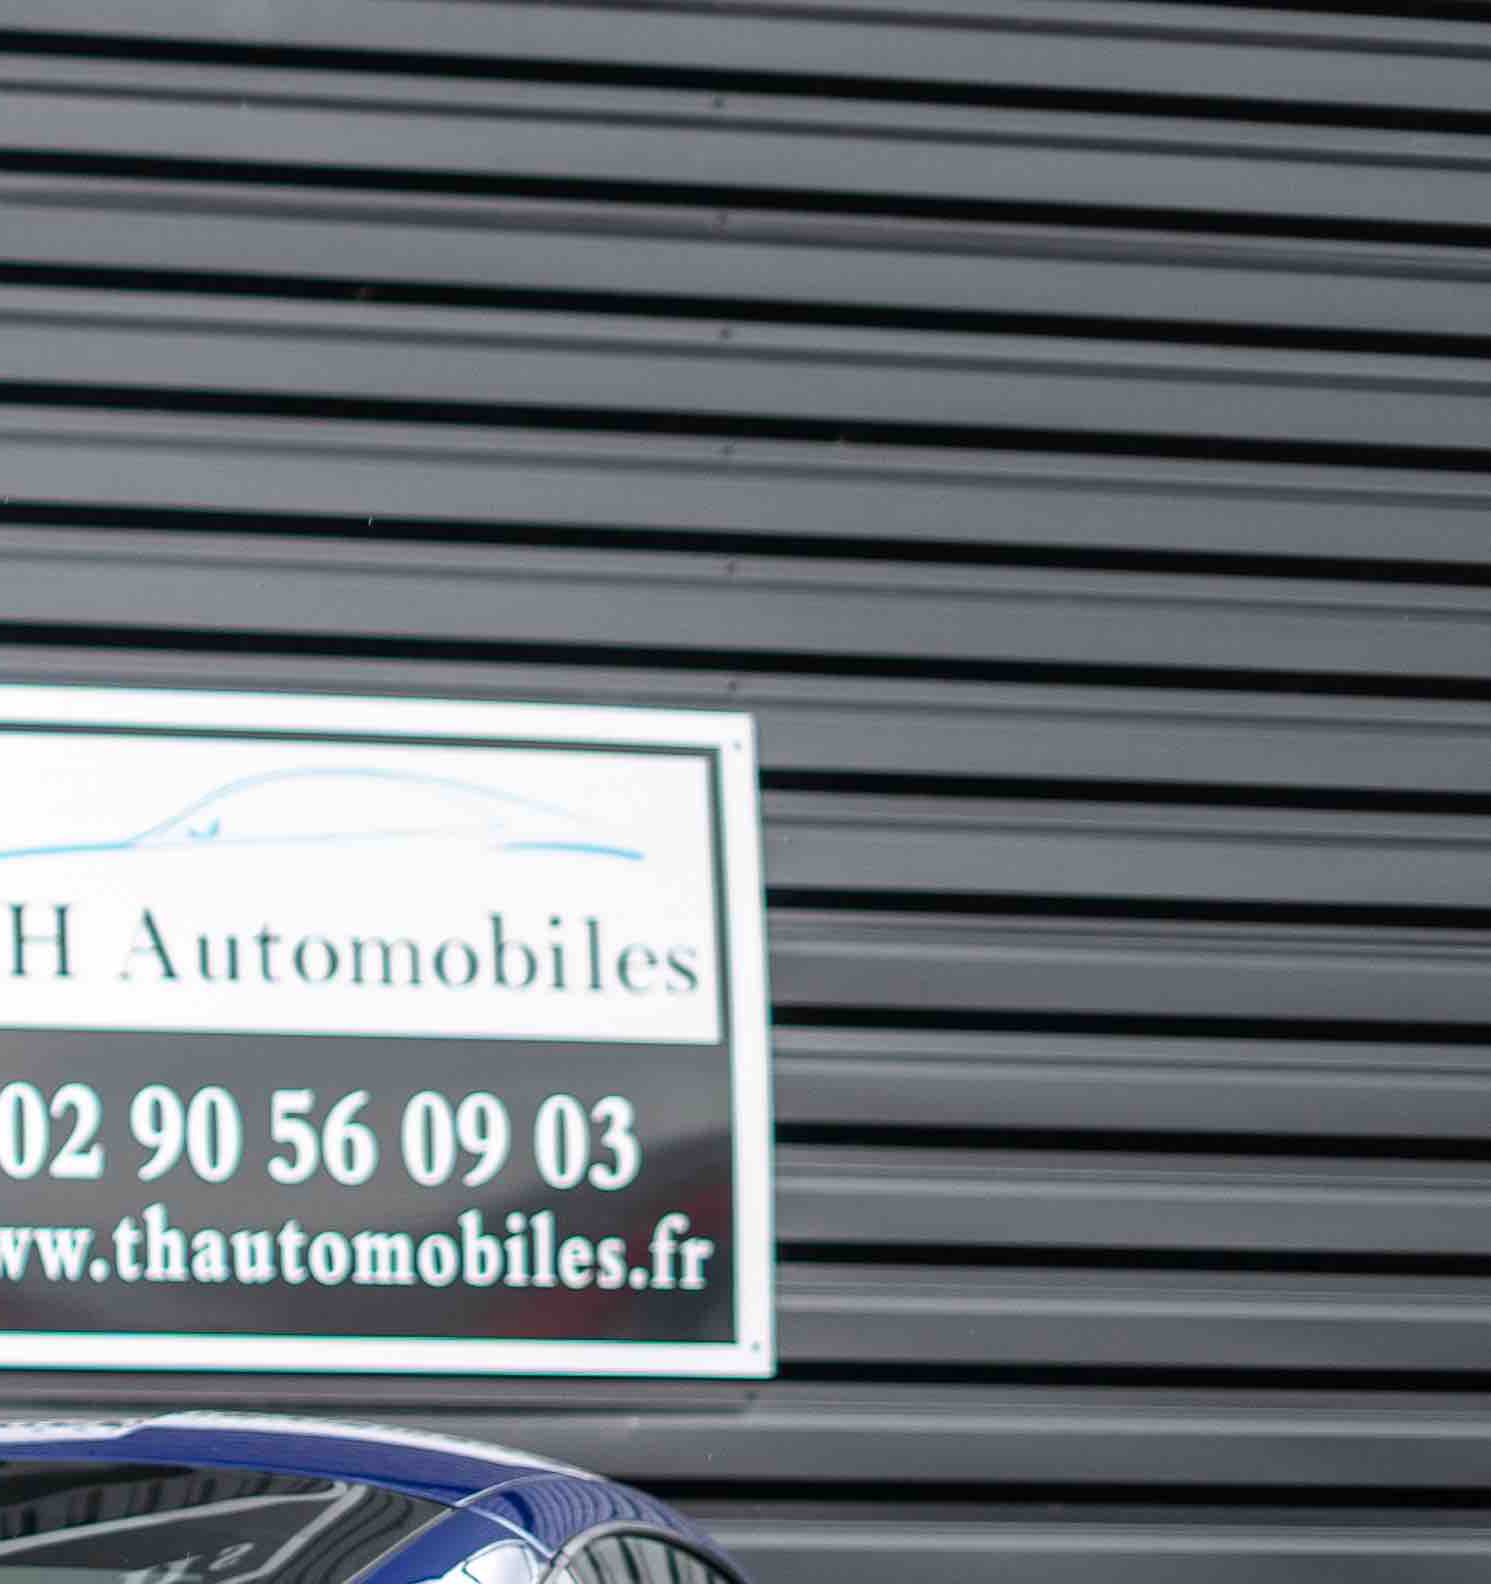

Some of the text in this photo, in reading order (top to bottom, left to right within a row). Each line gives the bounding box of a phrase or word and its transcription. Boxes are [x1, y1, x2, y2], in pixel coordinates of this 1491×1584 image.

[119, 907, 700, 996] Automobiles
[130, 1085, 242, 1182] 90
[268, 1089, 378, 1186] 56
[401, 1091, 511, 1187] 09
[534, 1094, 639, 1191] 03
